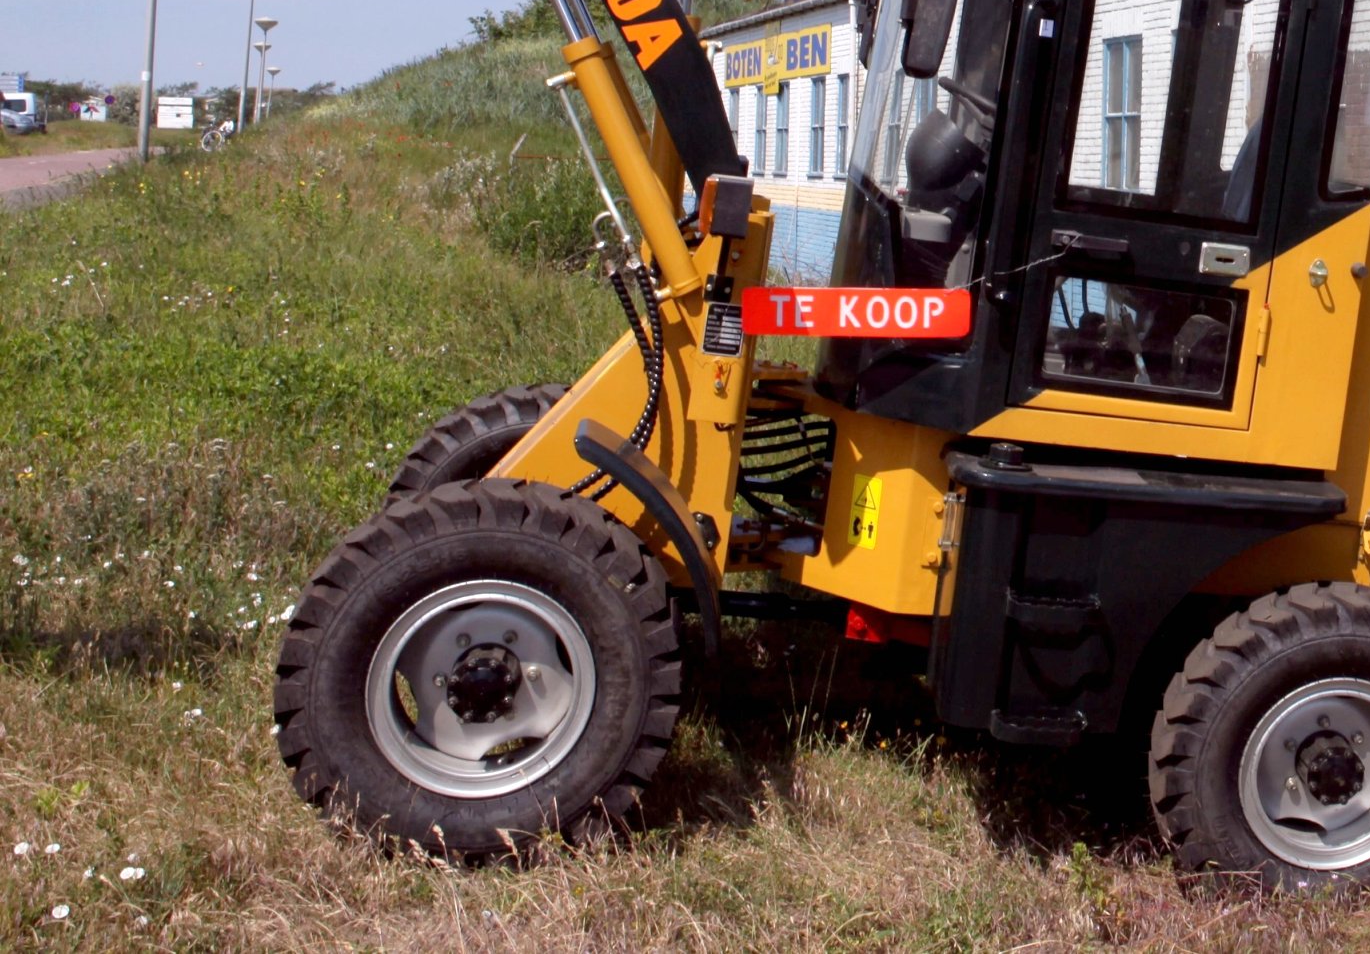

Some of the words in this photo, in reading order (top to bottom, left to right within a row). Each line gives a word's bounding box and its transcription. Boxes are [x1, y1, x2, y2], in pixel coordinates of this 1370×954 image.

[726, 46, 762, 80] BOTEN
[786, 32, 828, 71] BEN
[769, 294, 815, 329] TE
[839, 295, 945, 329] KOOP
